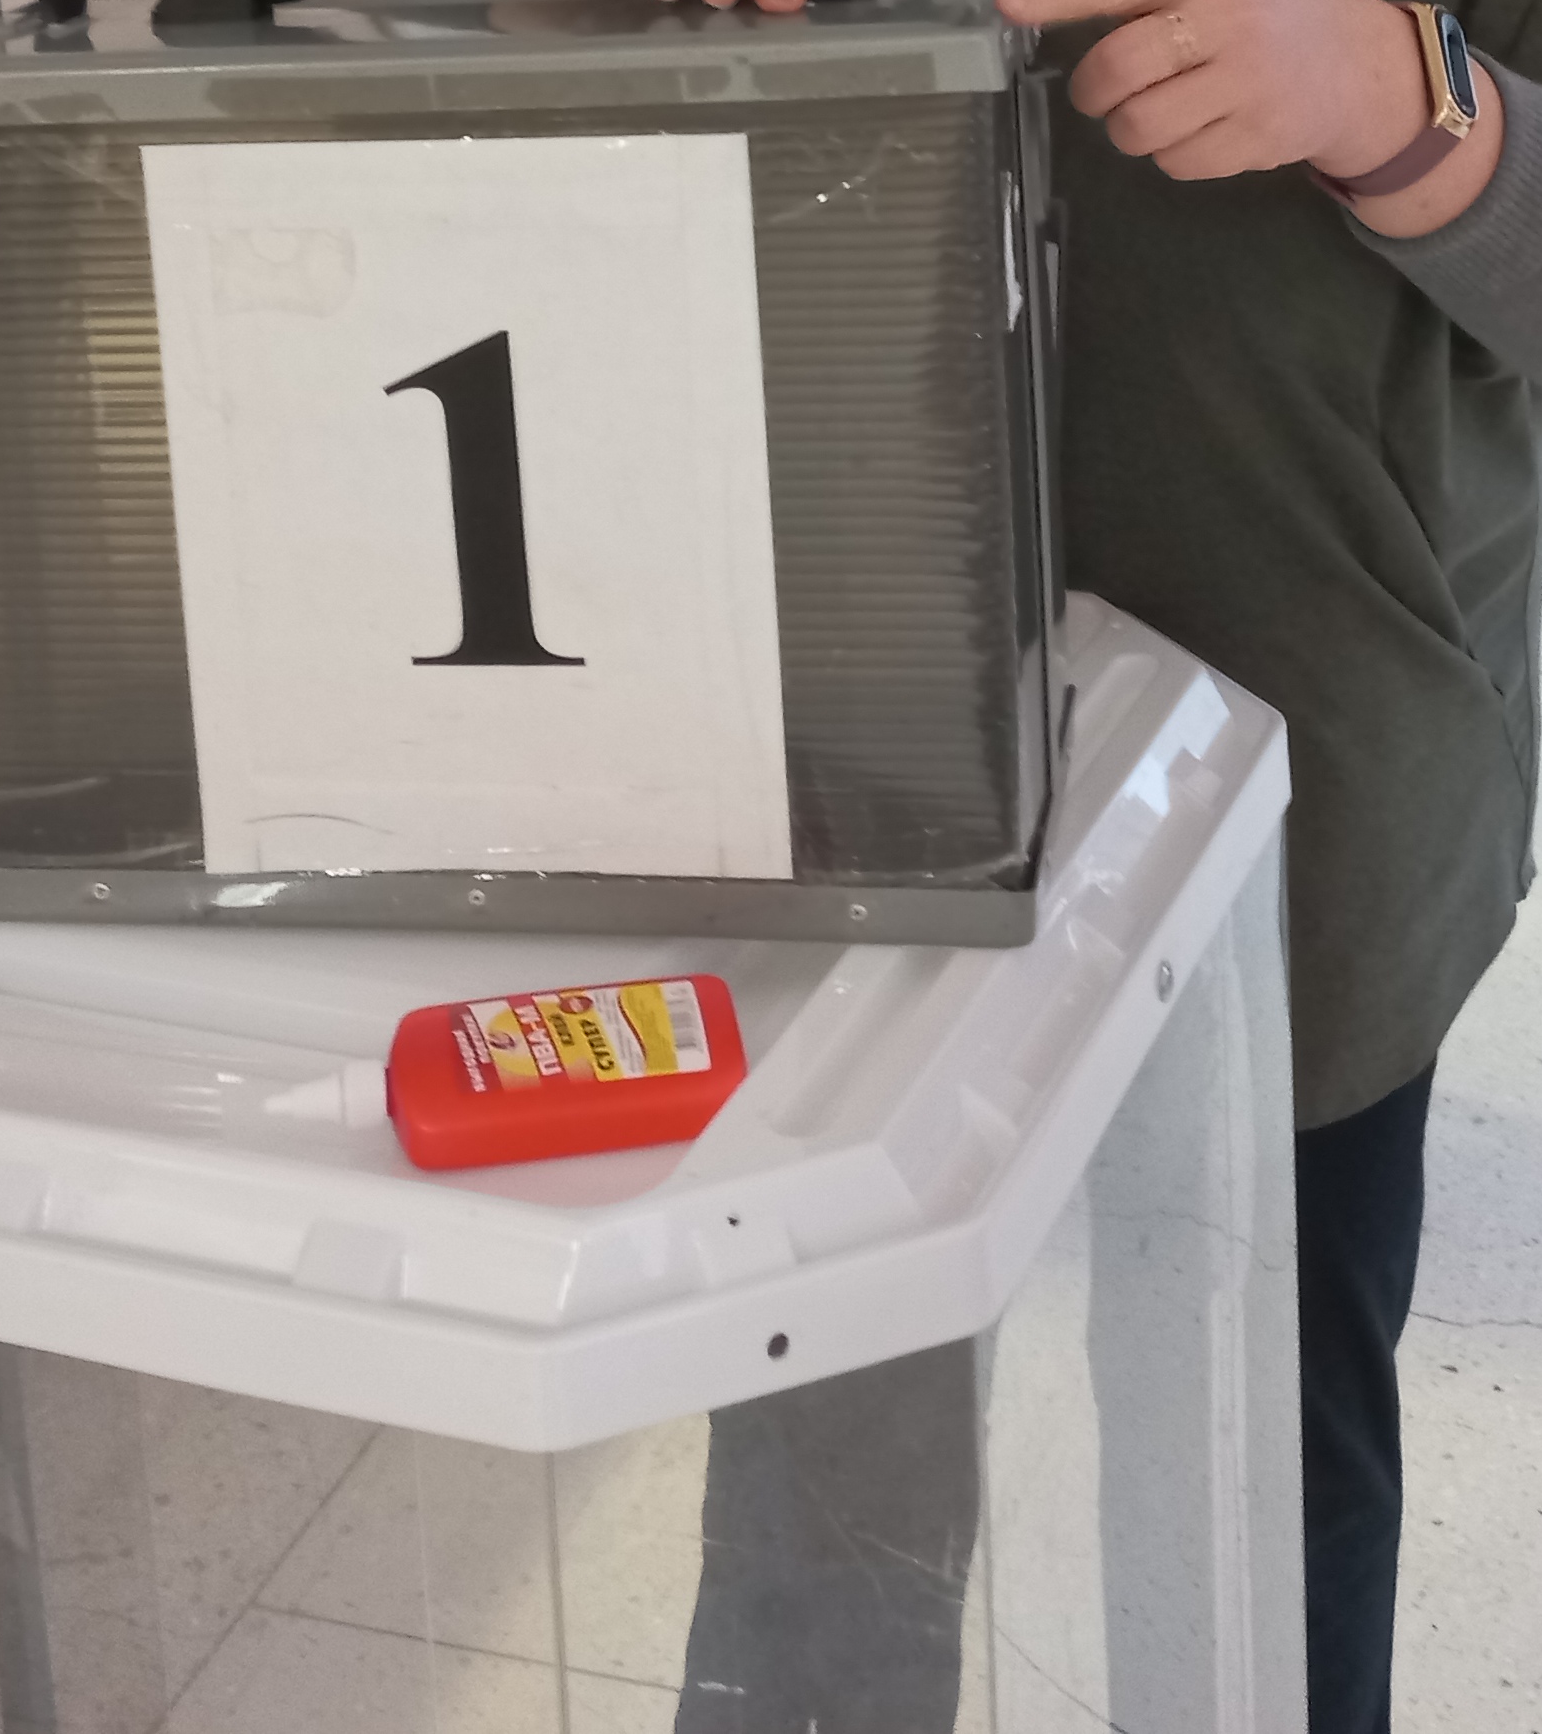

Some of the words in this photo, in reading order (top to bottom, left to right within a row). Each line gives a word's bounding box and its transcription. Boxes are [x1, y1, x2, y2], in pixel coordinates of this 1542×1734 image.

[383, 330, 586, 666] 1
[514, 1004, 563, 1077] ПВА-М
[579, 1019, 616, 1070] СУПЕР
